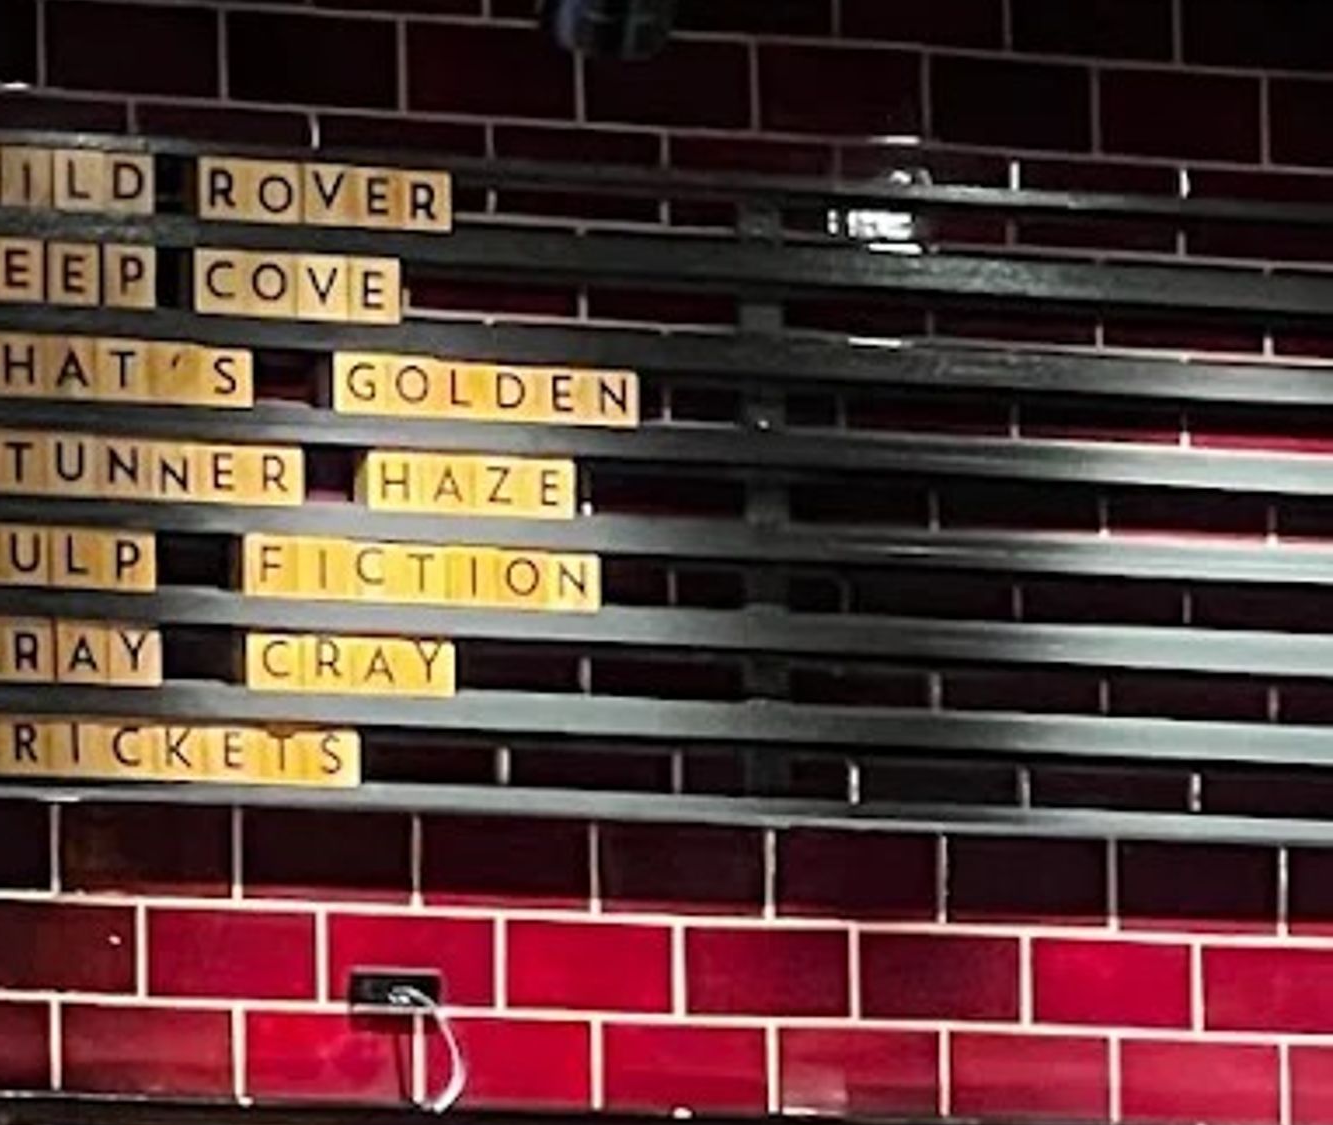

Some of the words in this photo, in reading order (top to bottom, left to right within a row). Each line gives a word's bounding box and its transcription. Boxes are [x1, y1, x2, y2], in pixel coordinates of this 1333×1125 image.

[207, 169, 439, 222] ROVER
[205, 262, 386, 310] COVE
[346, 363, 630, 417] GOLDEN
[380, 462, 562, 507] HAZE
[259, 546, 588, 597] FICTION
[261, 639, 438, 685] CRAY
